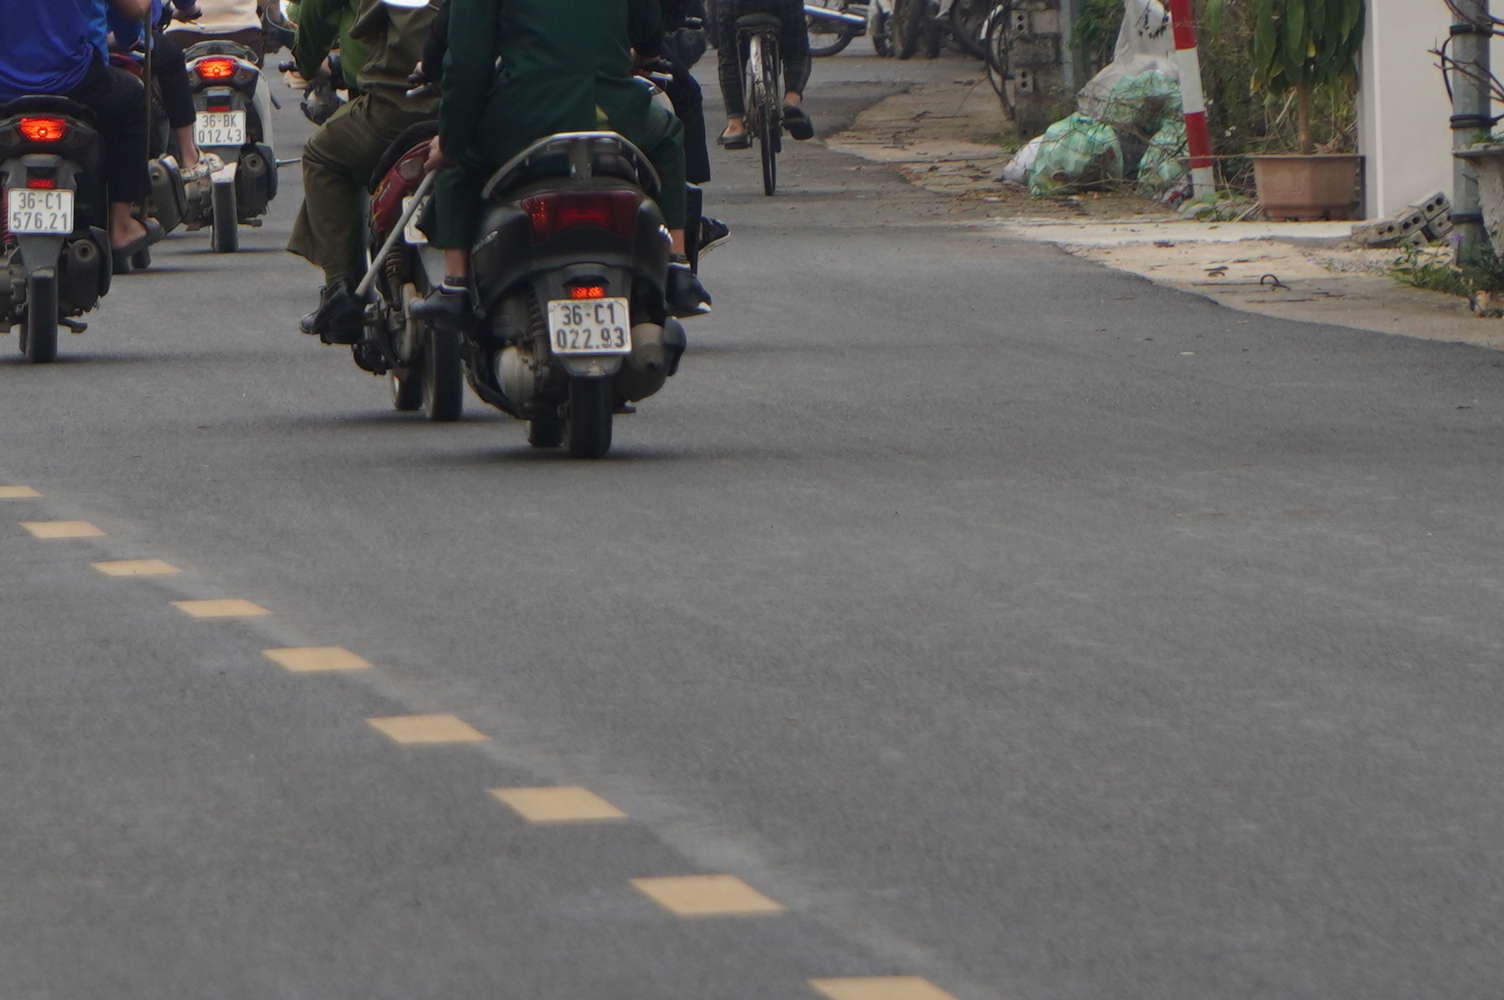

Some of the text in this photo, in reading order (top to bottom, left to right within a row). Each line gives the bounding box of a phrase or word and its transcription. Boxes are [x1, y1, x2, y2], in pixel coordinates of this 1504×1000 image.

[202, 114, 237, 128] 36-BK
[198, 129, 242, 143] 012.43
[18, 192, 62, 210] 36-C1
[12, 212, 68, 230] 576.21
[560, 302, 615, 325] 36-C1
[556, 326, 625, 349] 022.93
